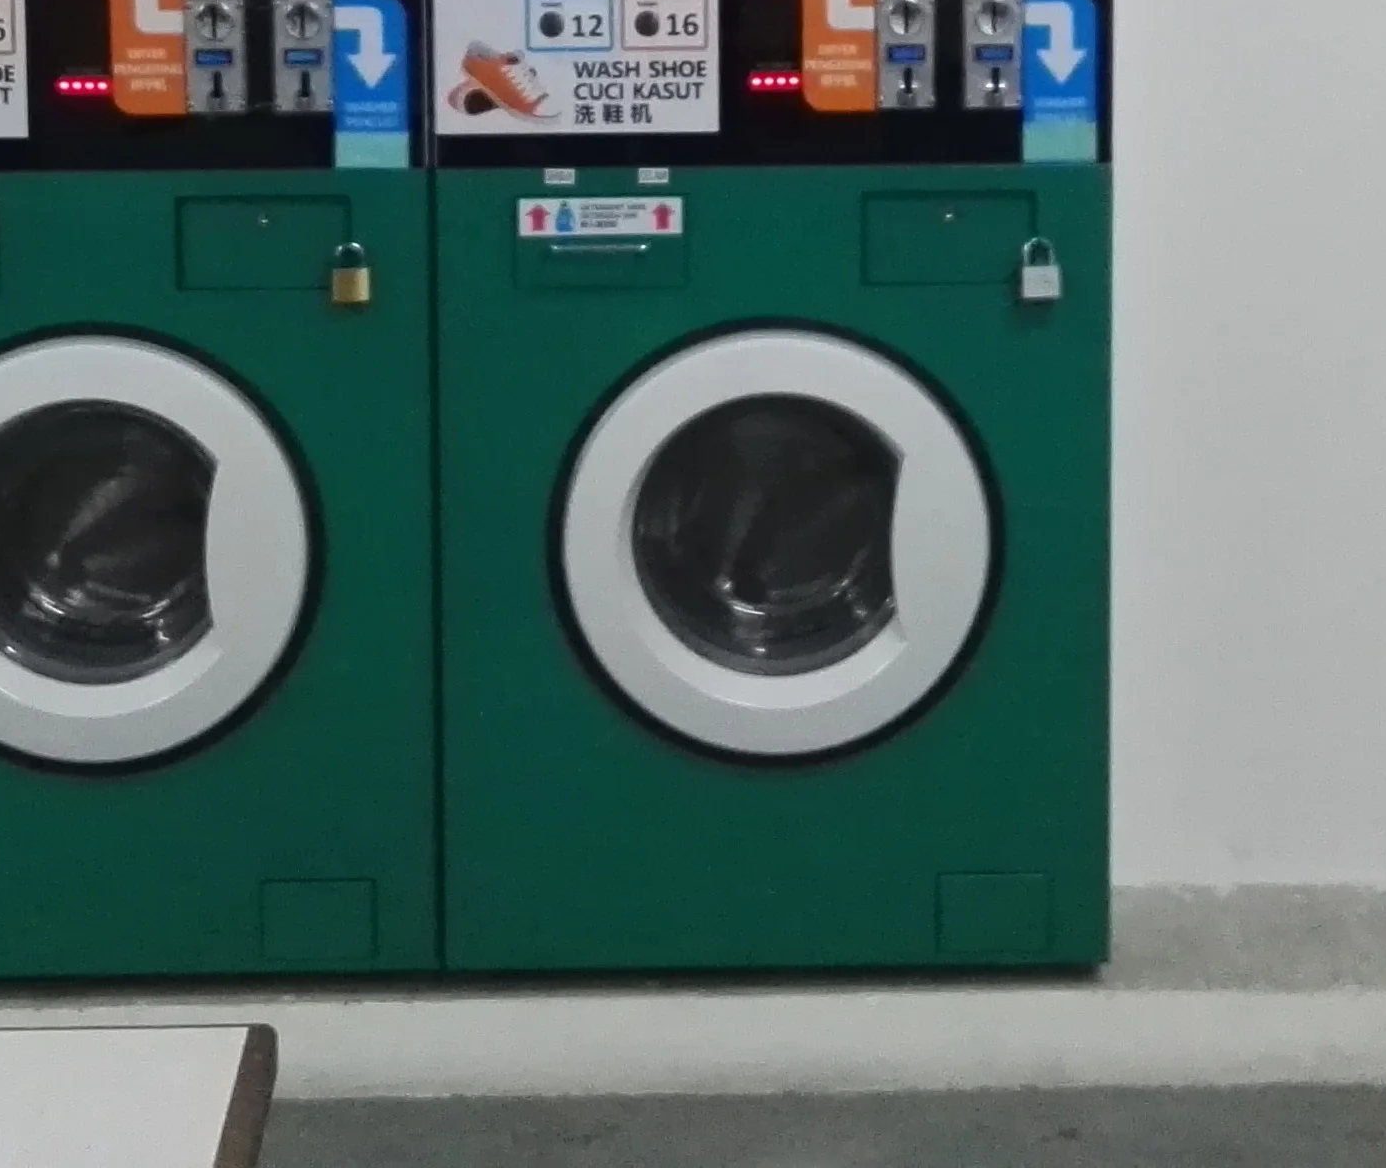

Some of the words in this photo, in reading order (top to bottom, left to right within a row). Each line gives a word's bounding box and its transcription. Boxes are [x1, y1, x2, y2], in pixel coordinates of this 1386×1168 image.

[571, 14, 604, 38] 12
[666, 13, 700, 37] 16
[573, 61, 641, 79] WASH
[648, 61, 707, 78] SHOE
[573, 83, 625, 101] CUCI
[633, 83, 704, 100] KASUT
